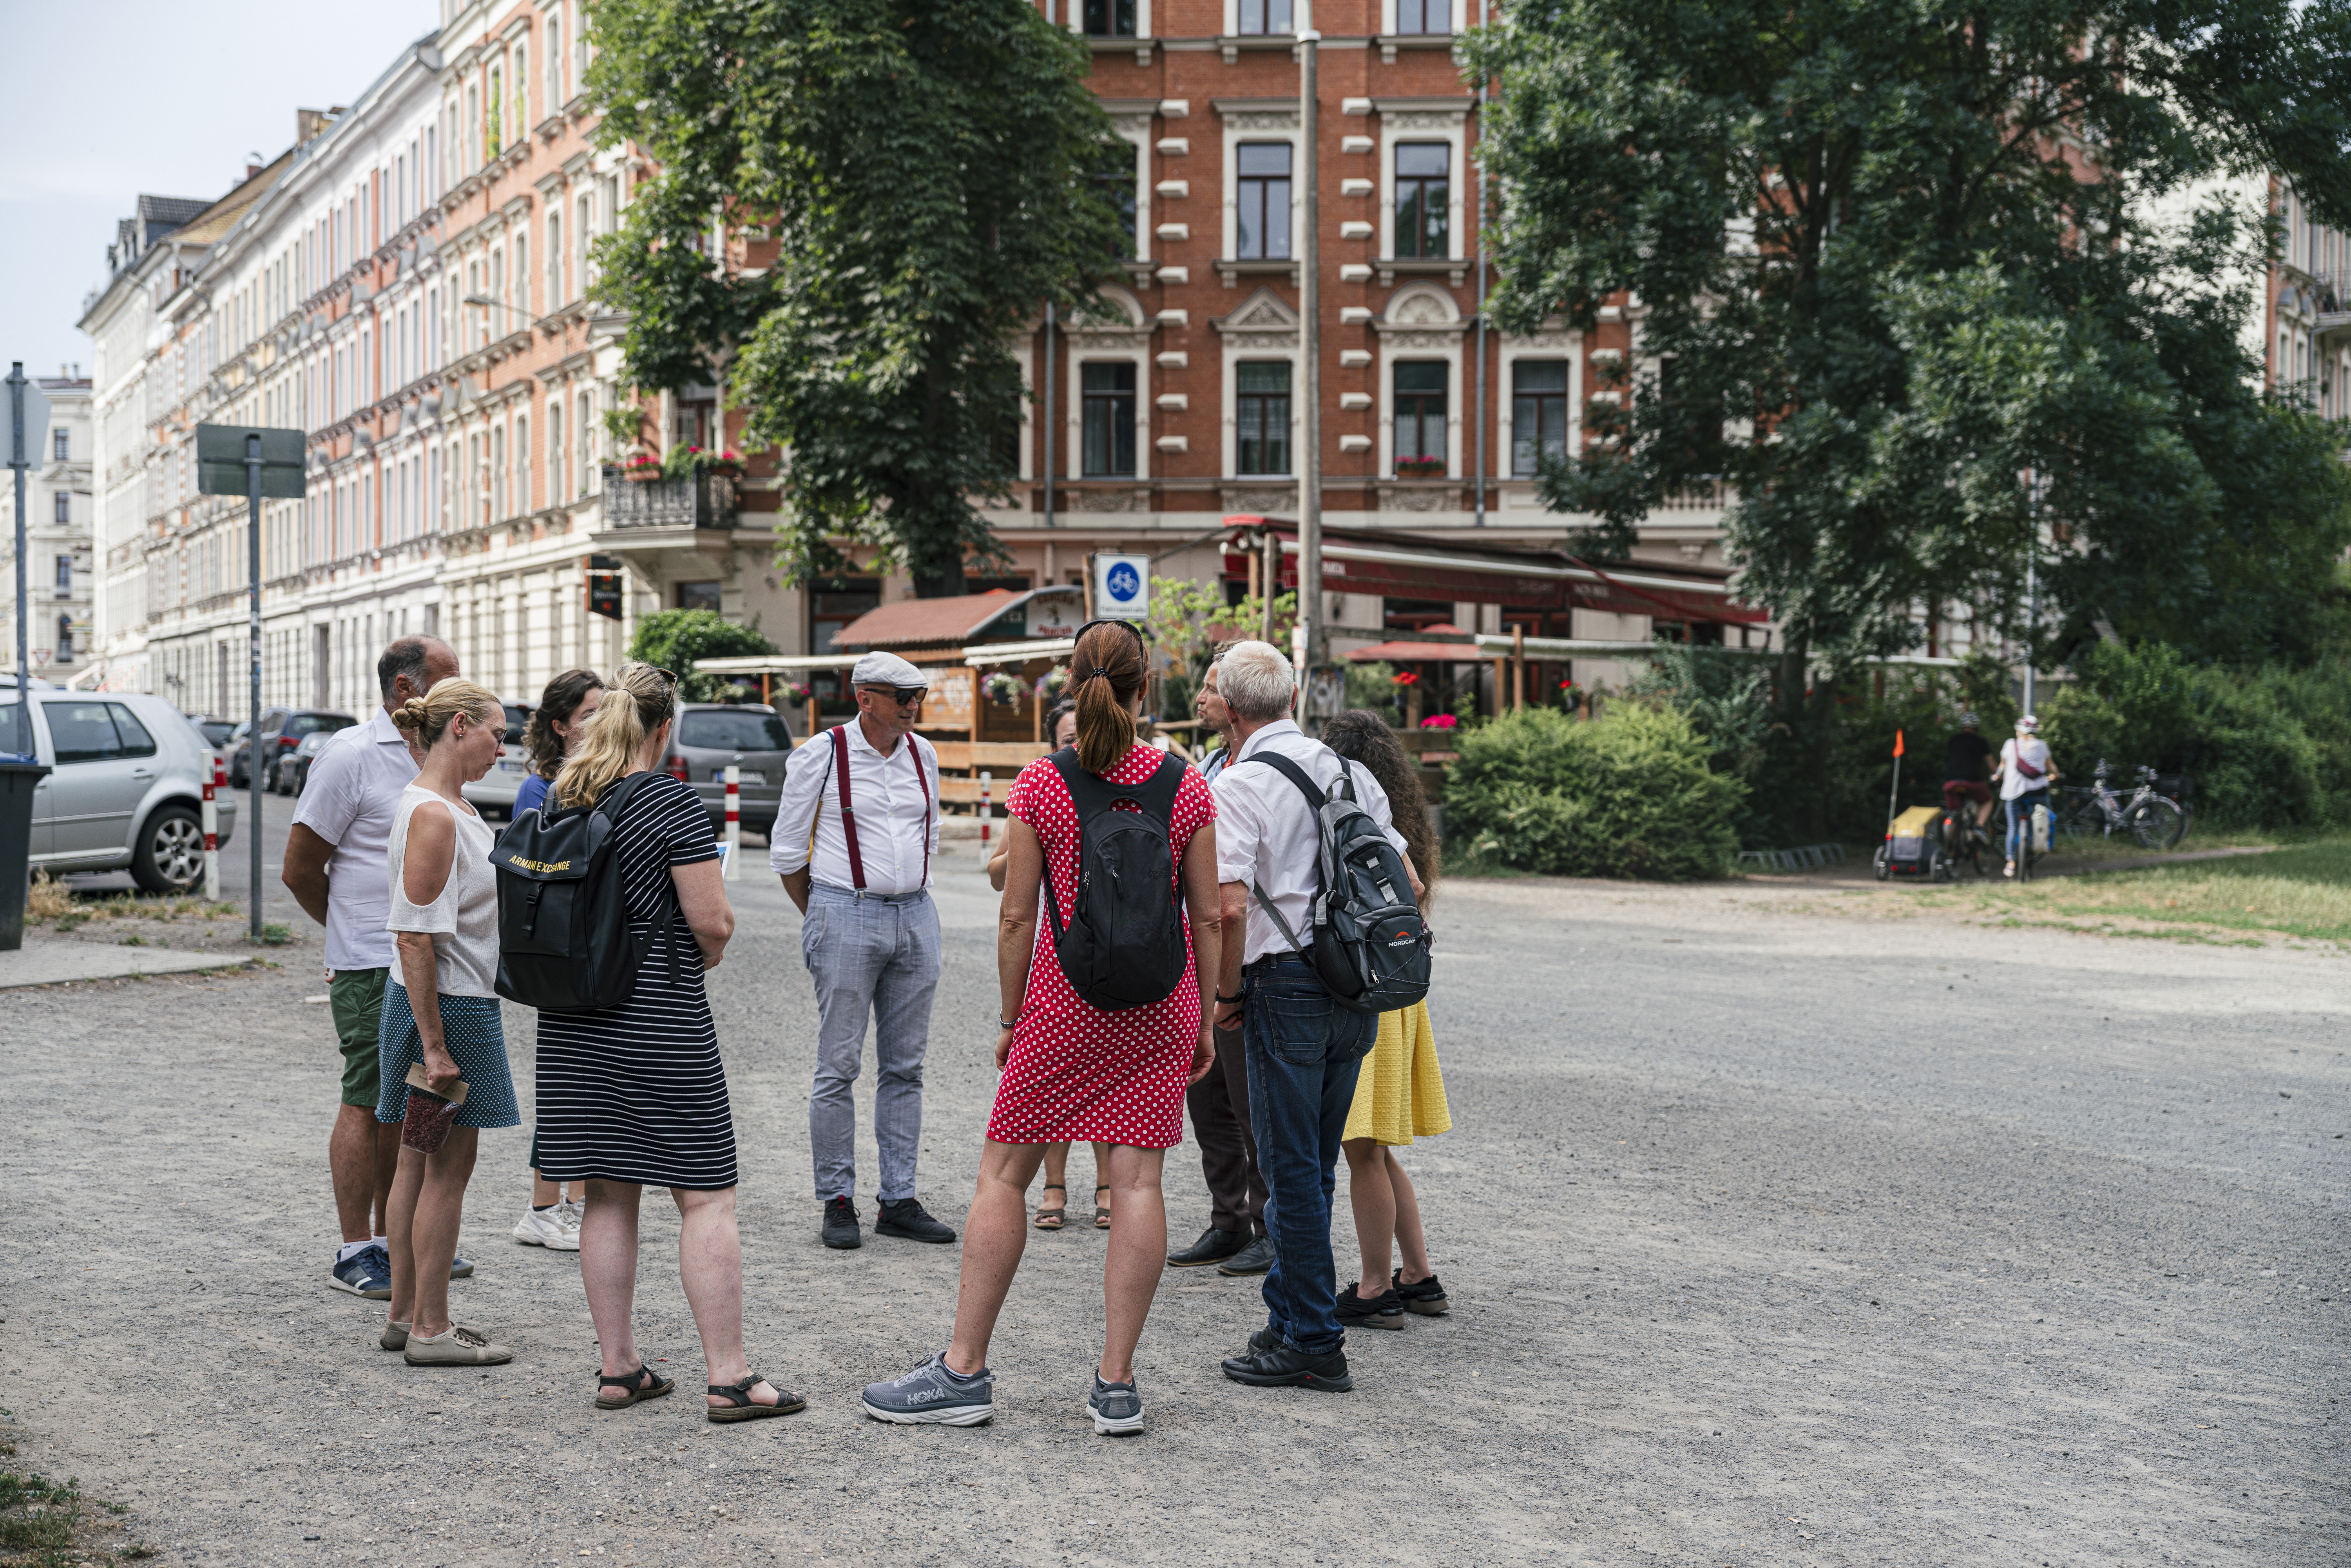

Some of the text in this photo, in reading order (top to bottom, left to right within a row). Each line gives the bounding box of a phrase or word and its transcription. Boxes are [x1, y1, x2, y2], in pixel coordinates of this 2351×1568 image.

[509, 855, 571, 873] ARMANI EXCHANGE
[1389, 938, 1416, 947] NORDCAP
[907, 1387, 945, 1406] HOKA
